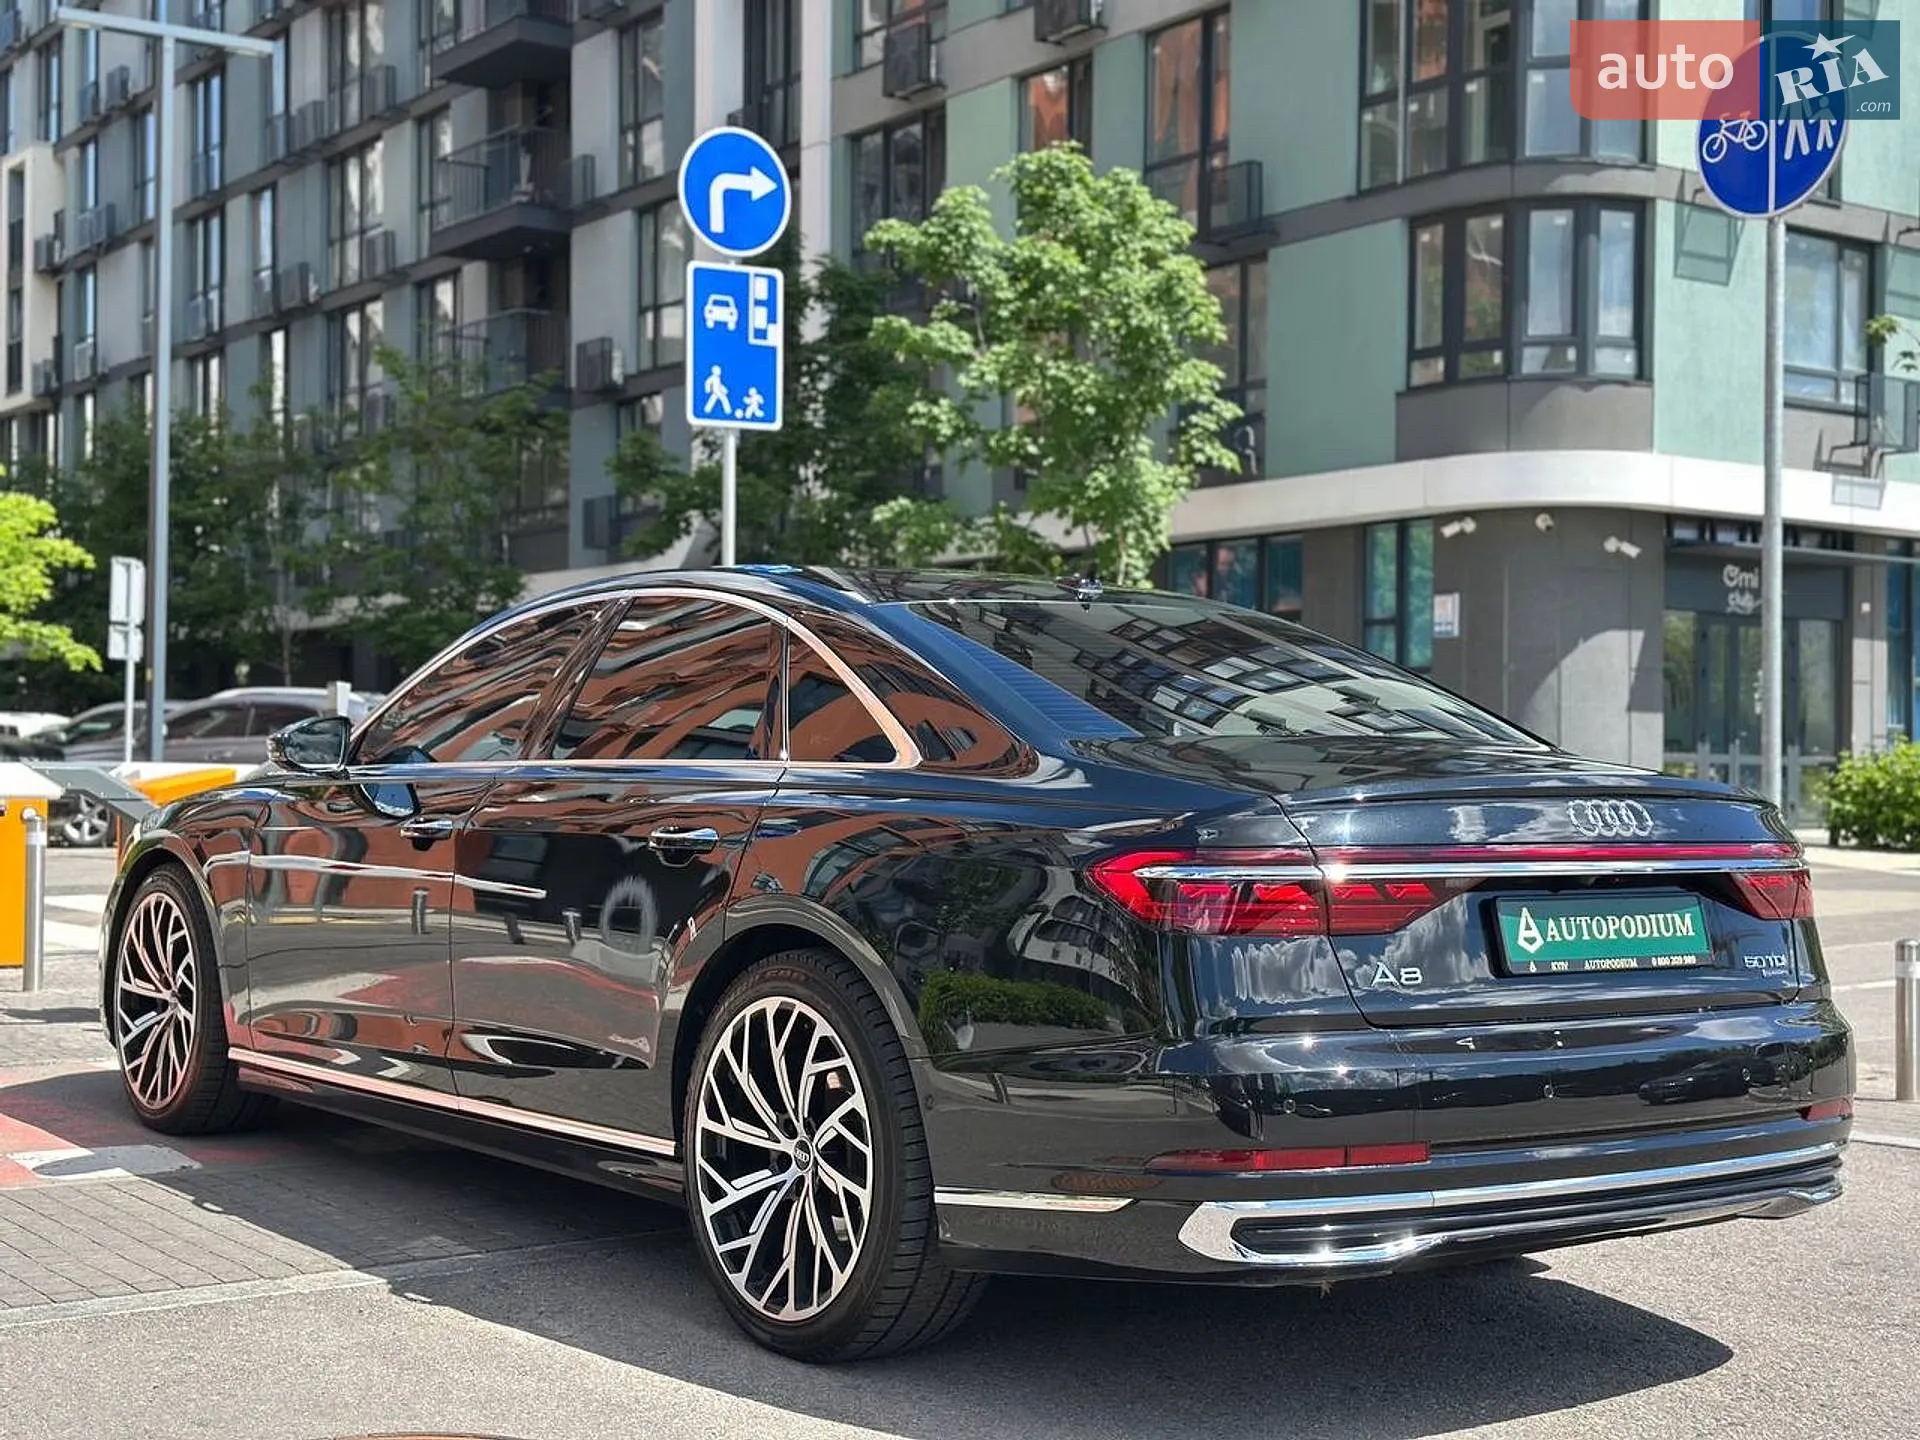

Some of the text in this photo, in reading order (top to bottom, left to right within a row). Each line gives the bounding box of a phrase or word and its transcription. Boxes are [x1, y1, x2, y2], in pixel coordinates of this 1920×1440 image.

[1546, 912, 1696, 942] AUTOPODIUM
[1584, 958, 1638, 970] AUTOPODIUM
[1744, 955, 1766, 968] 50
[1371, 961, 1422, 987] A8
